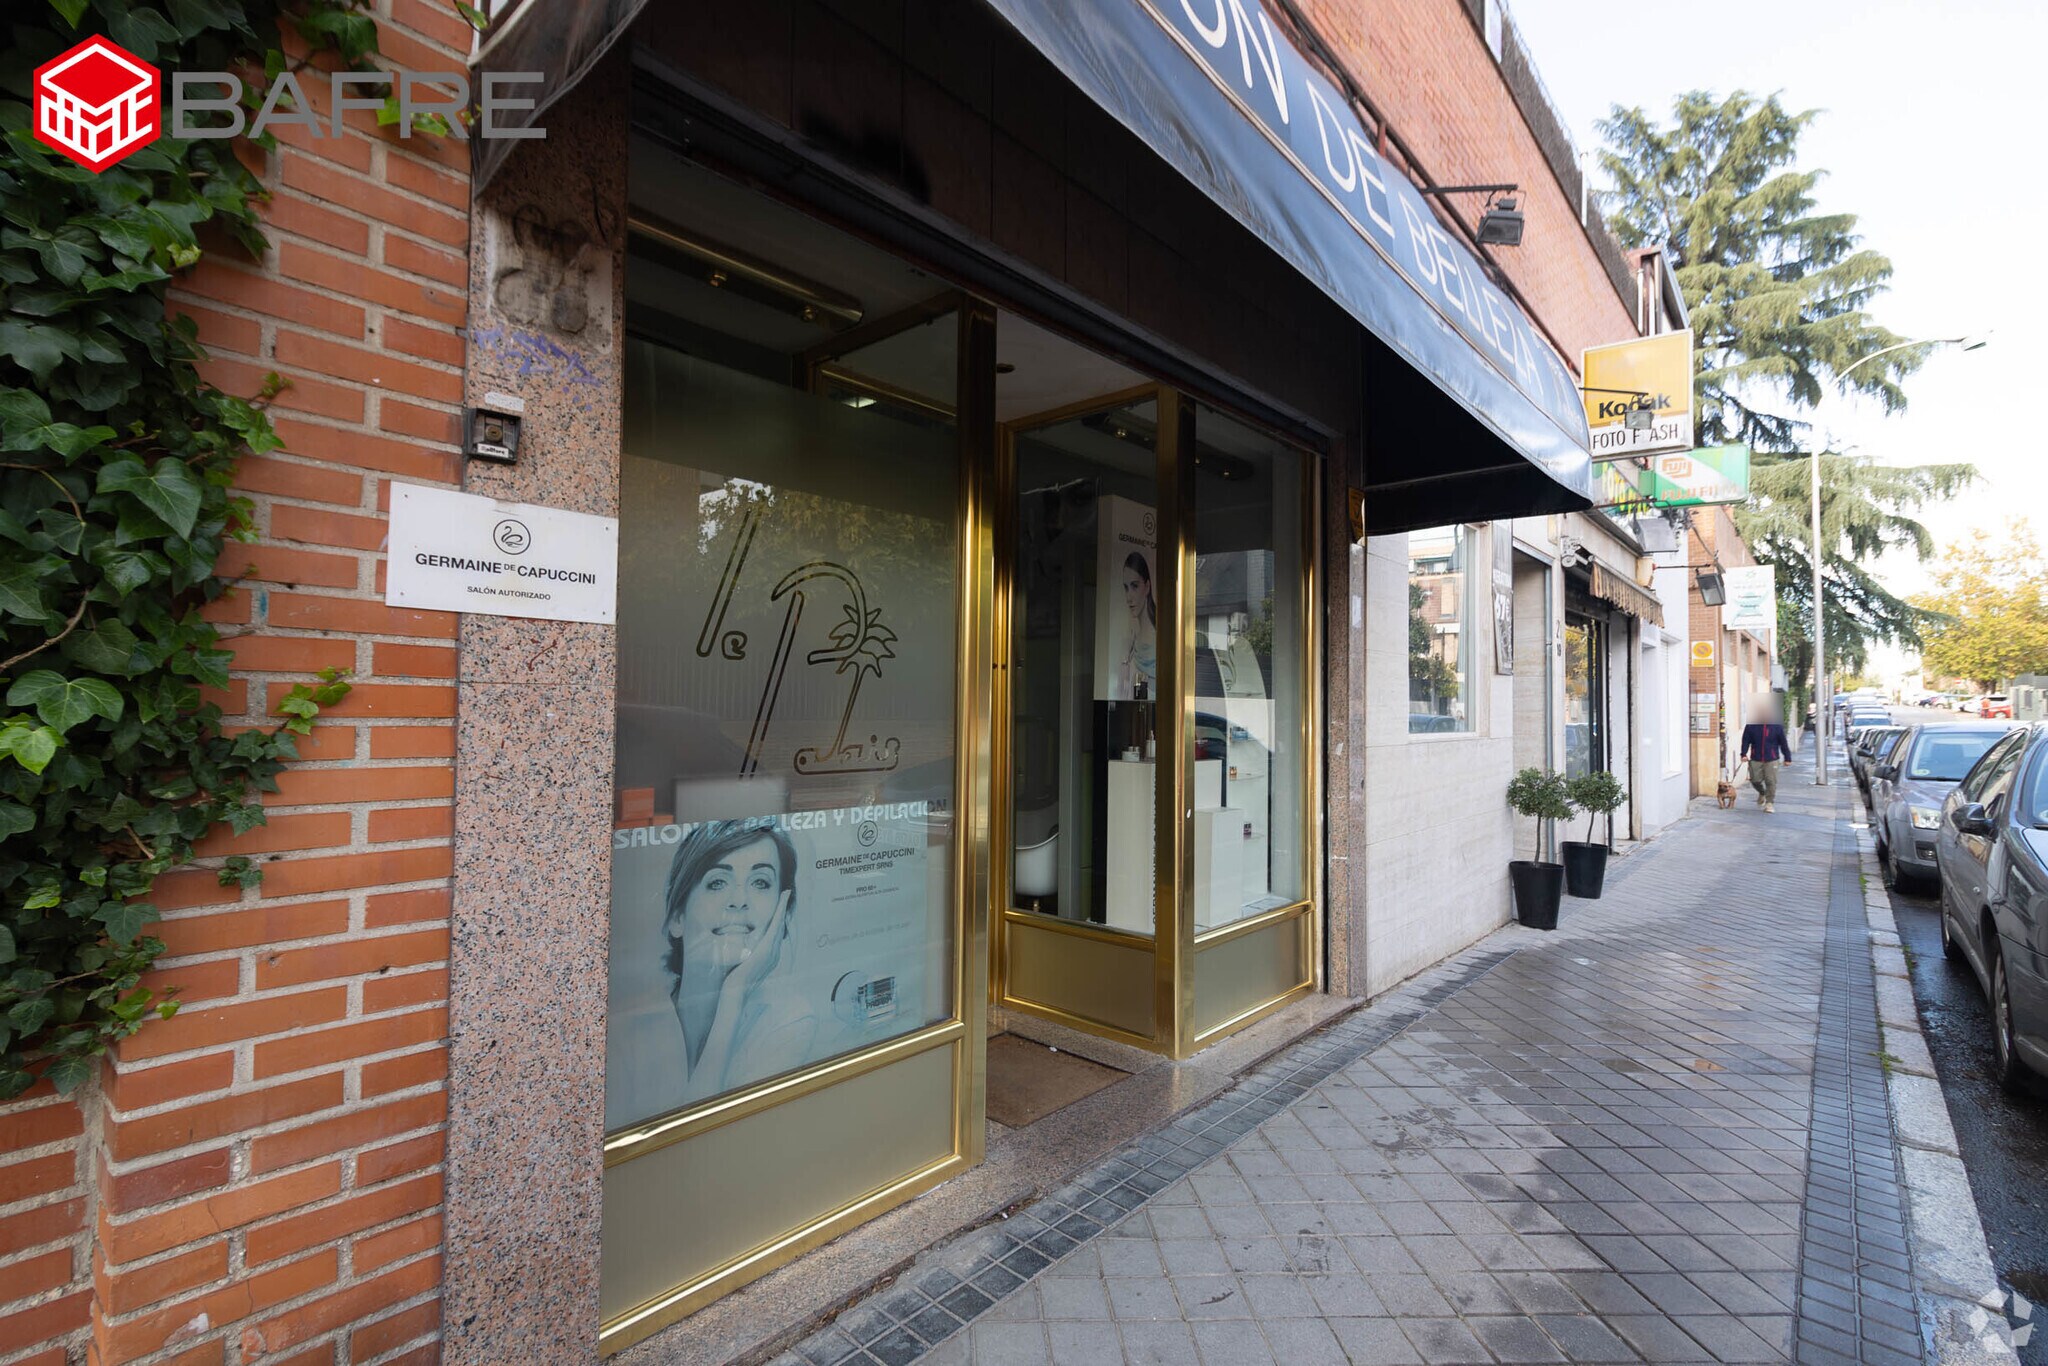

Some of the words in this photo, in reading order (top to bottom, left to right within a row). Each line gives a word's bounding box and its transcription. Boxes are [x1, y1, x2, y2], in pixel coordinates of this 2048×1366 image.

[1306, 79, 1396, 239] DE
[1397, 190, 1544, 397] BELLEZA
[1593, 430, 1626, 449] FOTO
[1633, 423, 1678, 444] FASH
[414, 553, 502, 574] GERMAINE
[503, 563, 516, 572] DE
[517, 565, 597, 585] CAPUCCINI
[467, 585, 496, 596] SALÓN
[498, 589, 552, 601] AUTORIZADO
[613, 821, 700, 850] SALON
[833, 808, 845, 827] Y
[815, 853, 862, 870] GERMAINE
[870, 847, 915, 862] CAPUCCINI
[839, 863, 875, 875] TIMEXPERT
